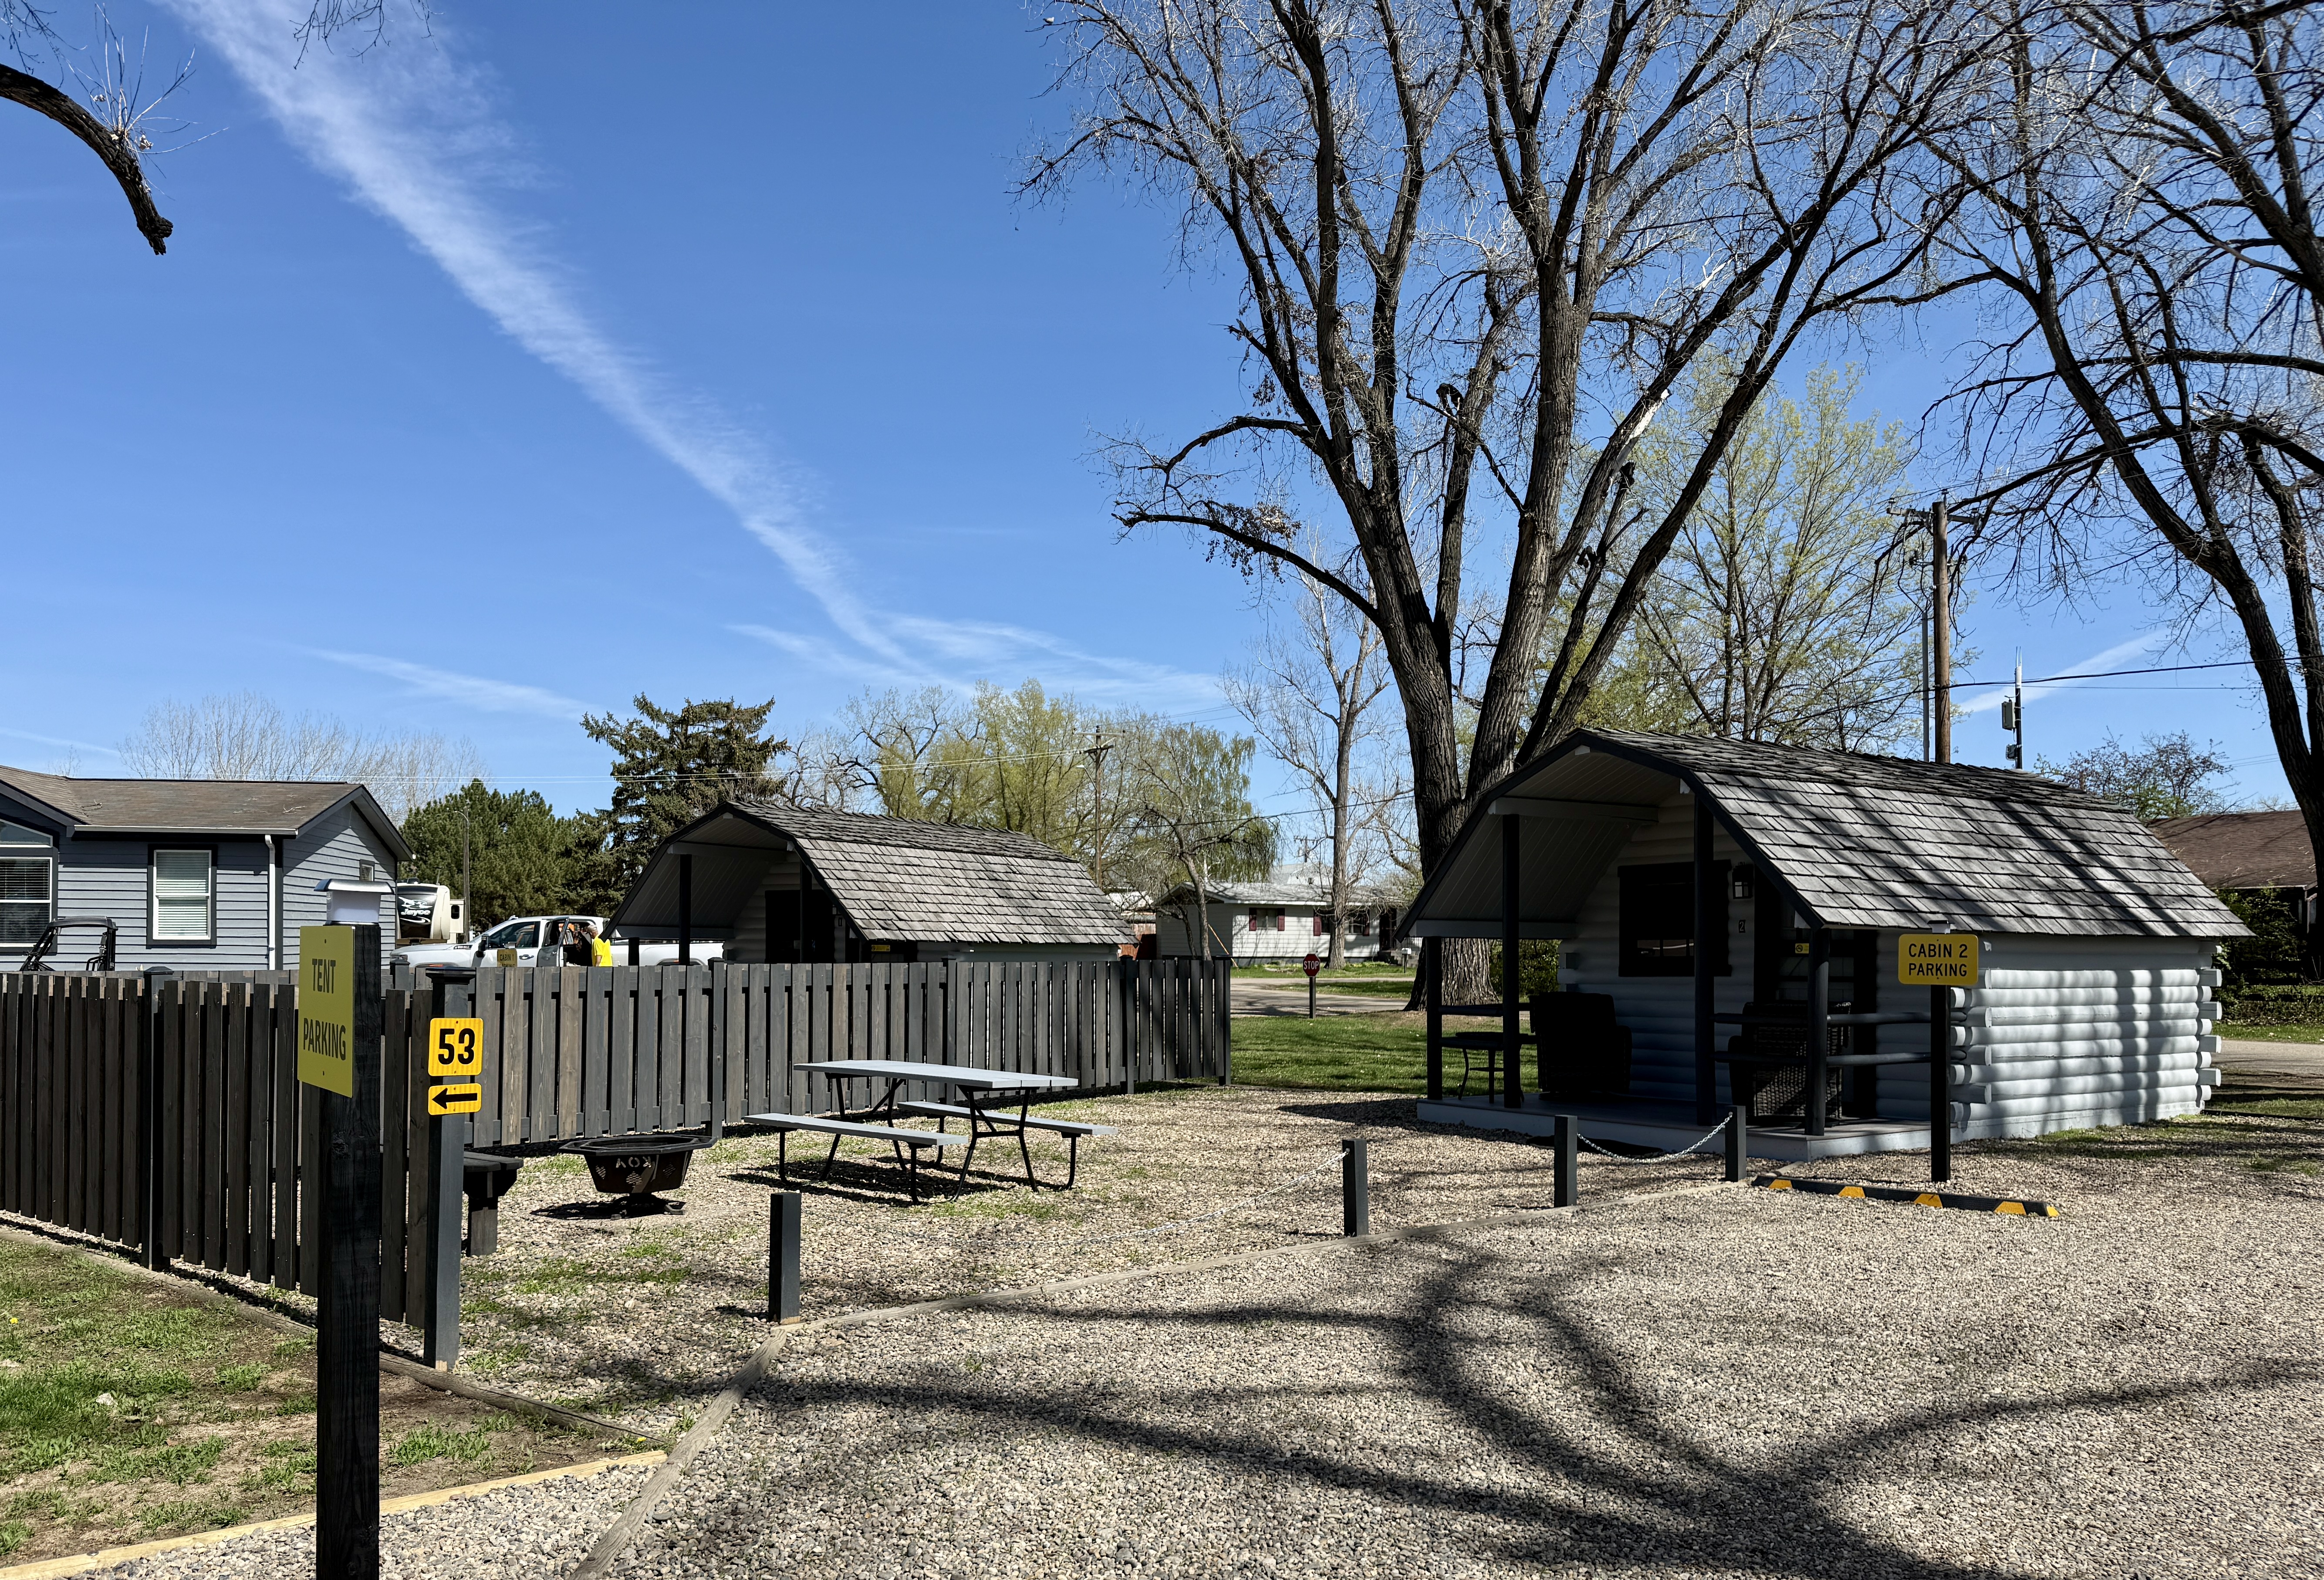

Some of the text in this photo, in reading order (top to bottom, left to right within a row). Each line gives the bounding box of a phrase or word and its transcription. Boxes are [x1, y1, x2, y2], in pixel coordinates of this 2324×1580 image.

[1739, 921, 1744, 931] 2
[1909, 943, 1968, 958] CABIN 2
[1304, 961, 1319, 970] STOP
[1909, 963, 1967, 977] PARKING
[312, 958, 336, 994] TENT
[303, 1018, 346, 1061] PARKING
[438, 1028, 475, 1065] 53
